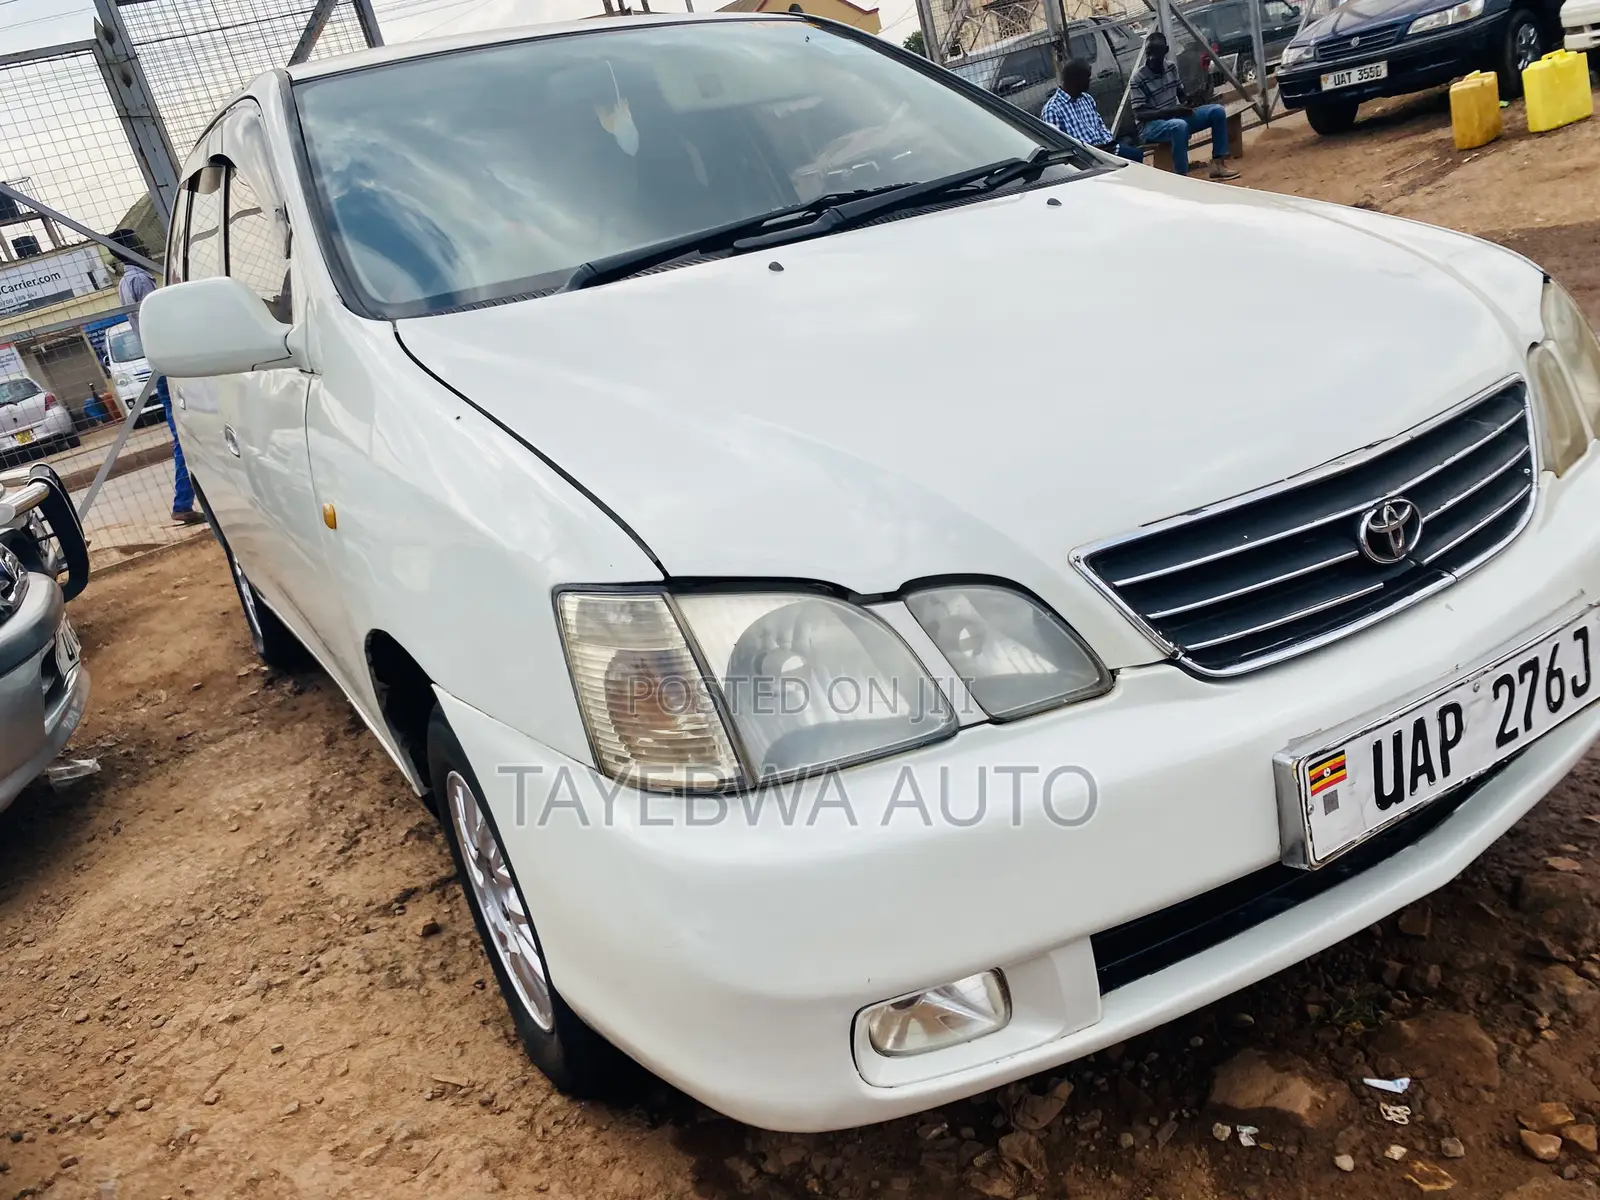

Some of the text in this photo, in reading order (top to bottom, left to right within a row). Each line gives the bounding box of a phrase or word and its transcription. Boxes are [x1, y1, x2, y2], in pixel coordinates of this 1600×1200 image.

[1333, 71, 1352, 86] UAT
[0, 272, 61, 295] Carrier.com
[1372, 625, 1591, 811] UAP 276J
